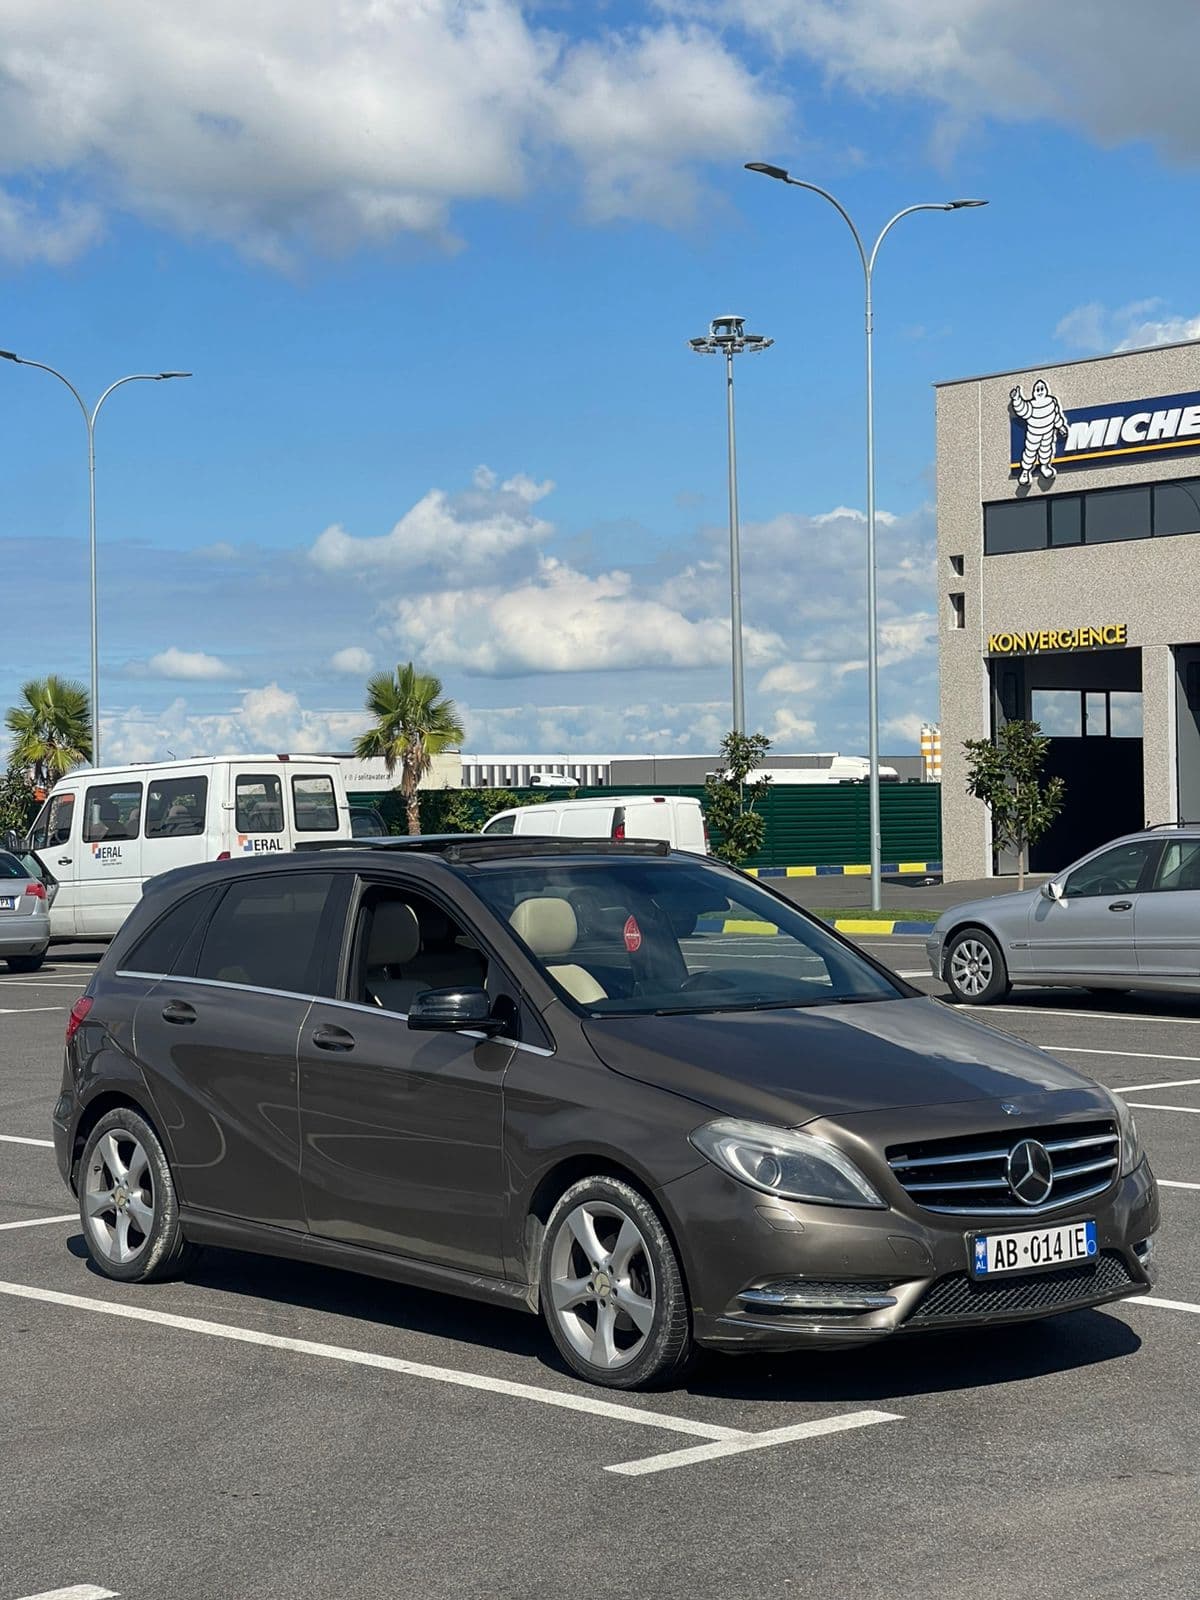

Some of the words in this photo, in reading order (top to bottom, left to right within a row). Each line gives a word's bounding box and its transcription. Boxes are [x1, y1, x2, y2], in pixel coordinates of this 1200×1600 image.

[1064, 405, 1200, 451] MICHE
[988, 624, 1126, 652] KONVERGJENCE
[102, 846, 122, 858] ERAL
[254, 838, 283, 851] ERAL
[994, 1239, 1018, 1269] AB
[1030, 1231, 1063, 1263] 014
[1069, 1228, 1086, 1258] IE
[976, 1261, 986, 1270] AL
